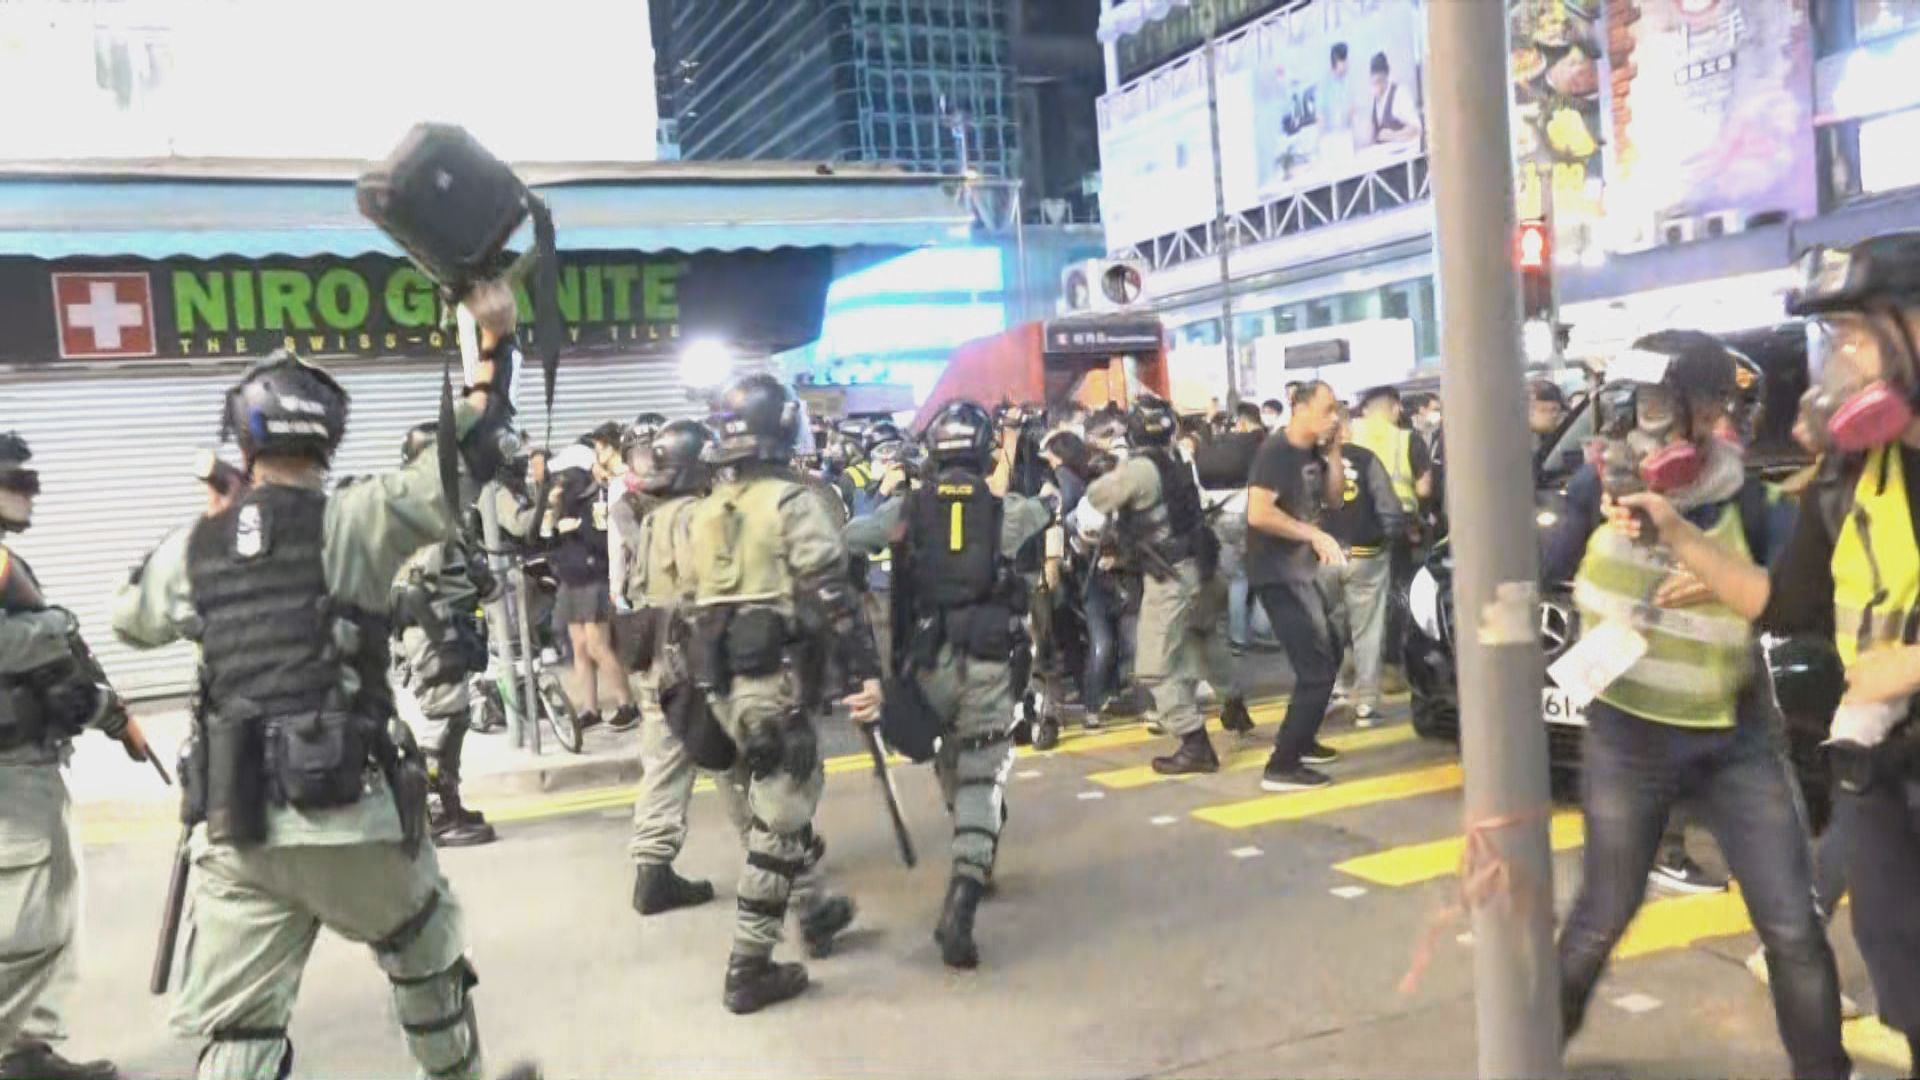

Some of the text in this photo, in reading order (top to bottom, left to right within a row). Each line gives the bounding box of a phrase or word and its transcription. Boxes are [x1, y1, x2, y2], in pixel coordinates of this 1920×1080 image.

[173, 267, 370, 332] NIRO
[180, 336, 248, 354] THE
[610, 323, 681, 342] TILE
